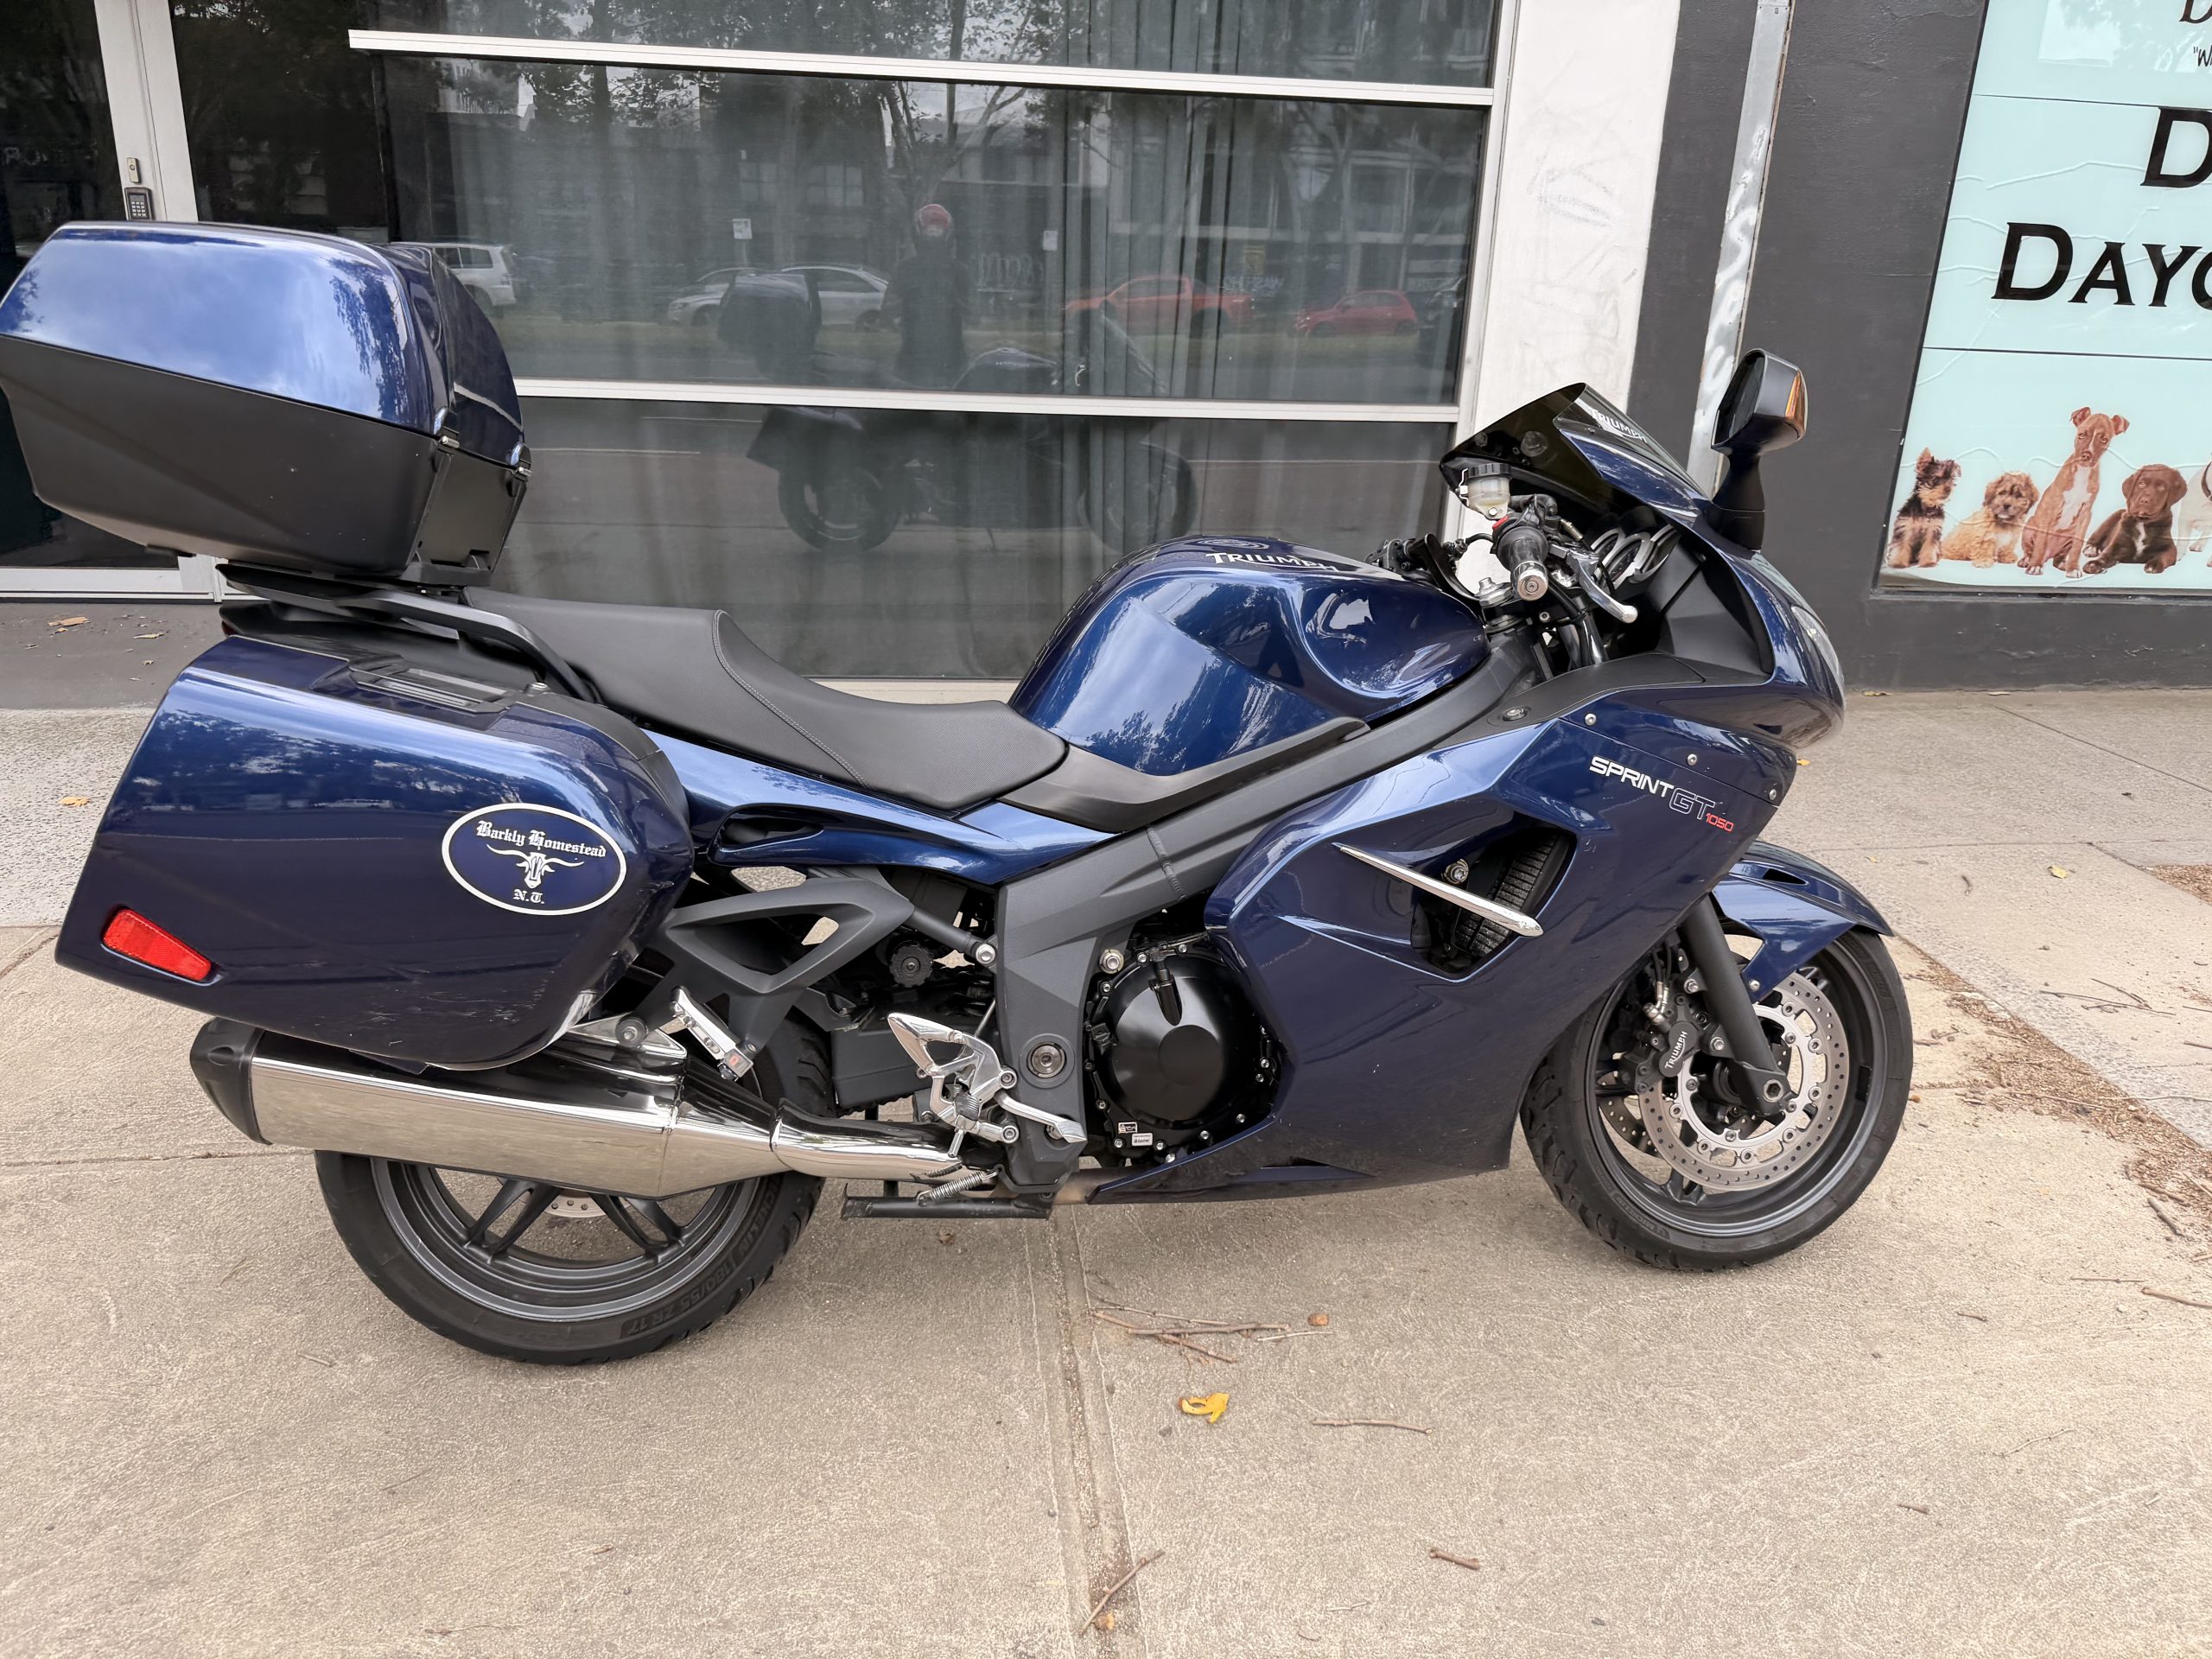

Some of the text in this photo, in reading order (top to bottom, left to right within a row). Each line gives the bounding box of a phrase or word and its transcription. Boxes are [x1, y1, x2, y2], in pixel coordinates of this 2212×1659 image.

[1590, 407, 1649, 444] TRIUMPH
[1205, 552, 1339, 572] TRIUMPH
[1589, 755, 1734, 833] SPRINT GT 1050
[476, 820, 607, 858] Barkly Homestead
[512, 888, 545, 905] N.T.
[1664, 1030, 1688, 1070] TRIUMPH
[680, 1260, 733, 1309] 180/55
[627, 1318, 649, 1336] 17
